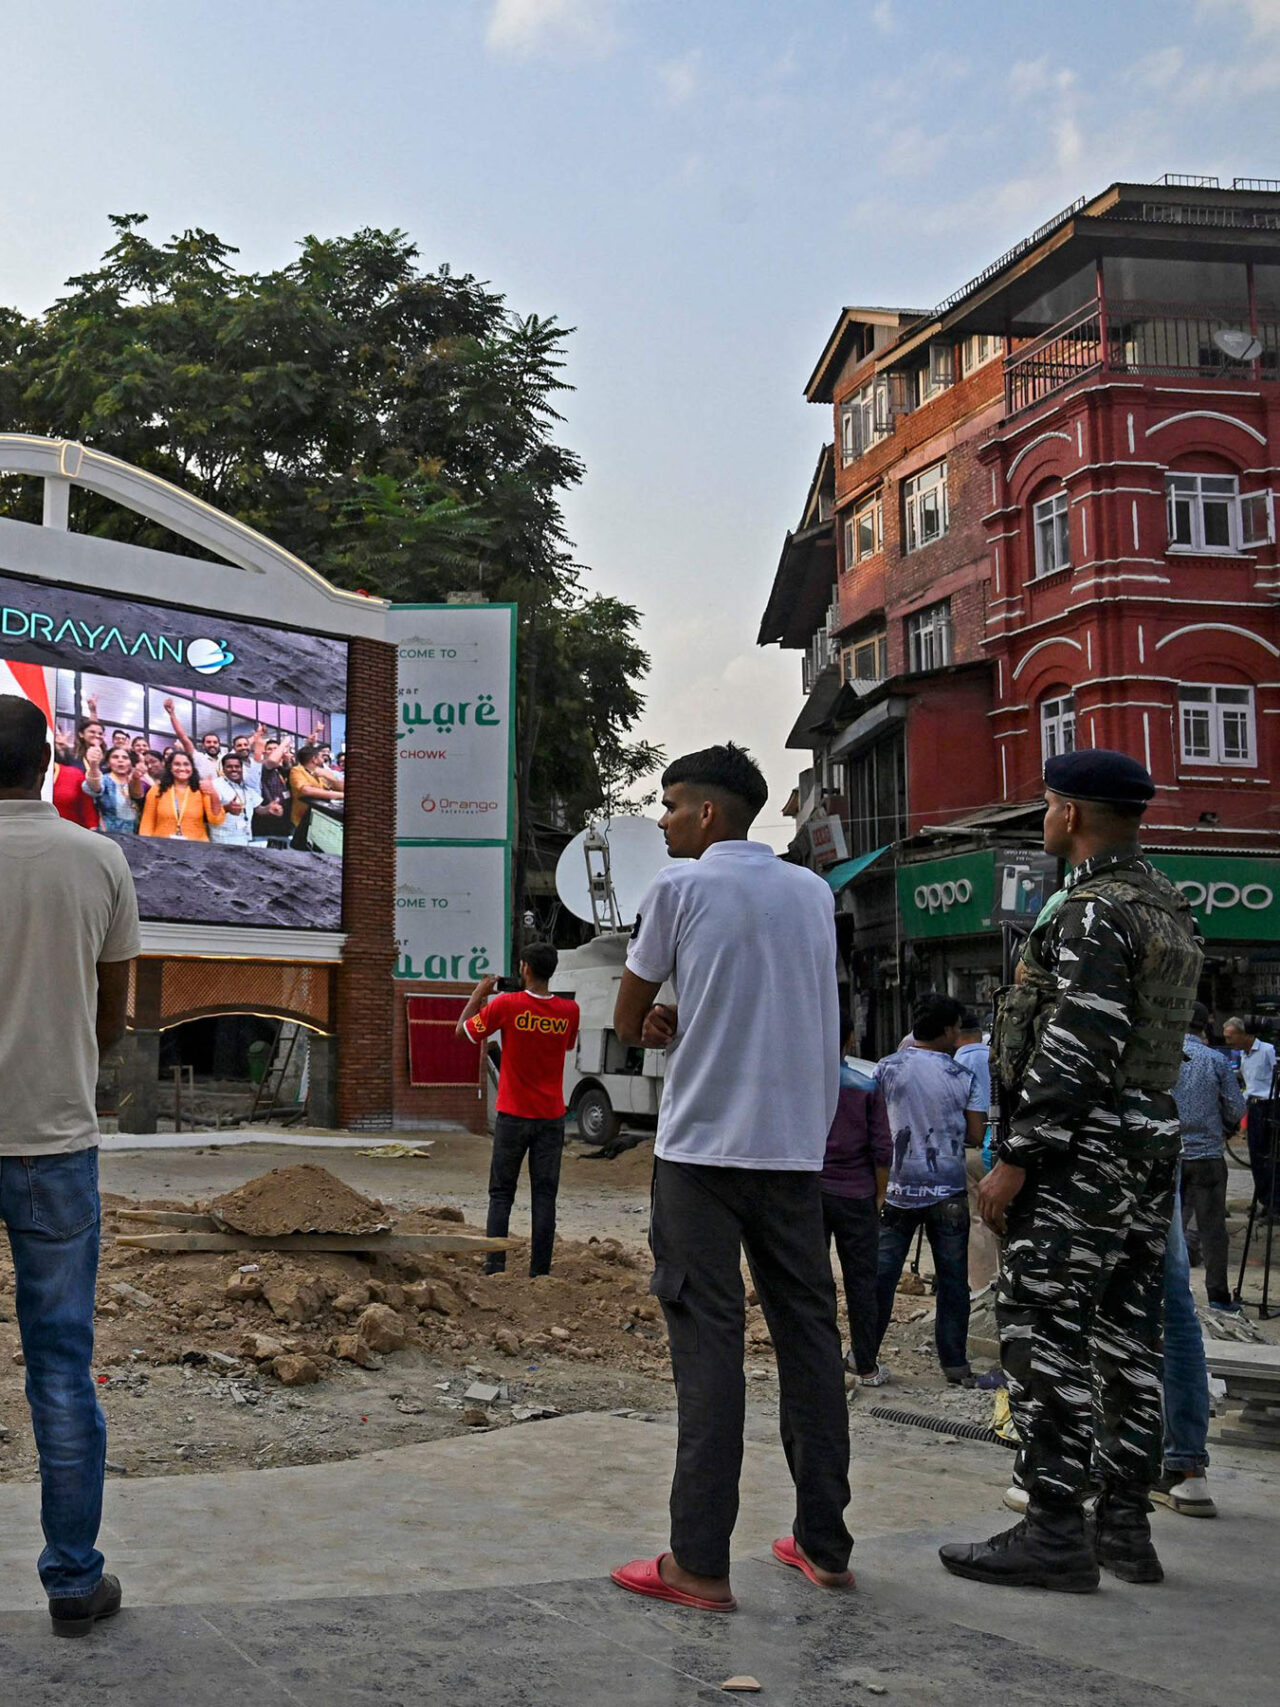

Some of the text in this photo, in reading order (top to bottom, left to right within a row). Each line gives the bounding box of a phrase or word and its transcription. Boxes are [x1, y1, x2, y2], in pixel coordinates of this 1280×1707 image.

[441, 649, 457, 659] TO
[400, 750, 448, 760] CHOWK
[439, 799, 499, 813] Orango
[395, 898, 449, 908] OME TO
[914, 878, 973, 915] oppo
[1175, 881, 1273, 915] ppo
[515, 1010, 569, 1035] drew
